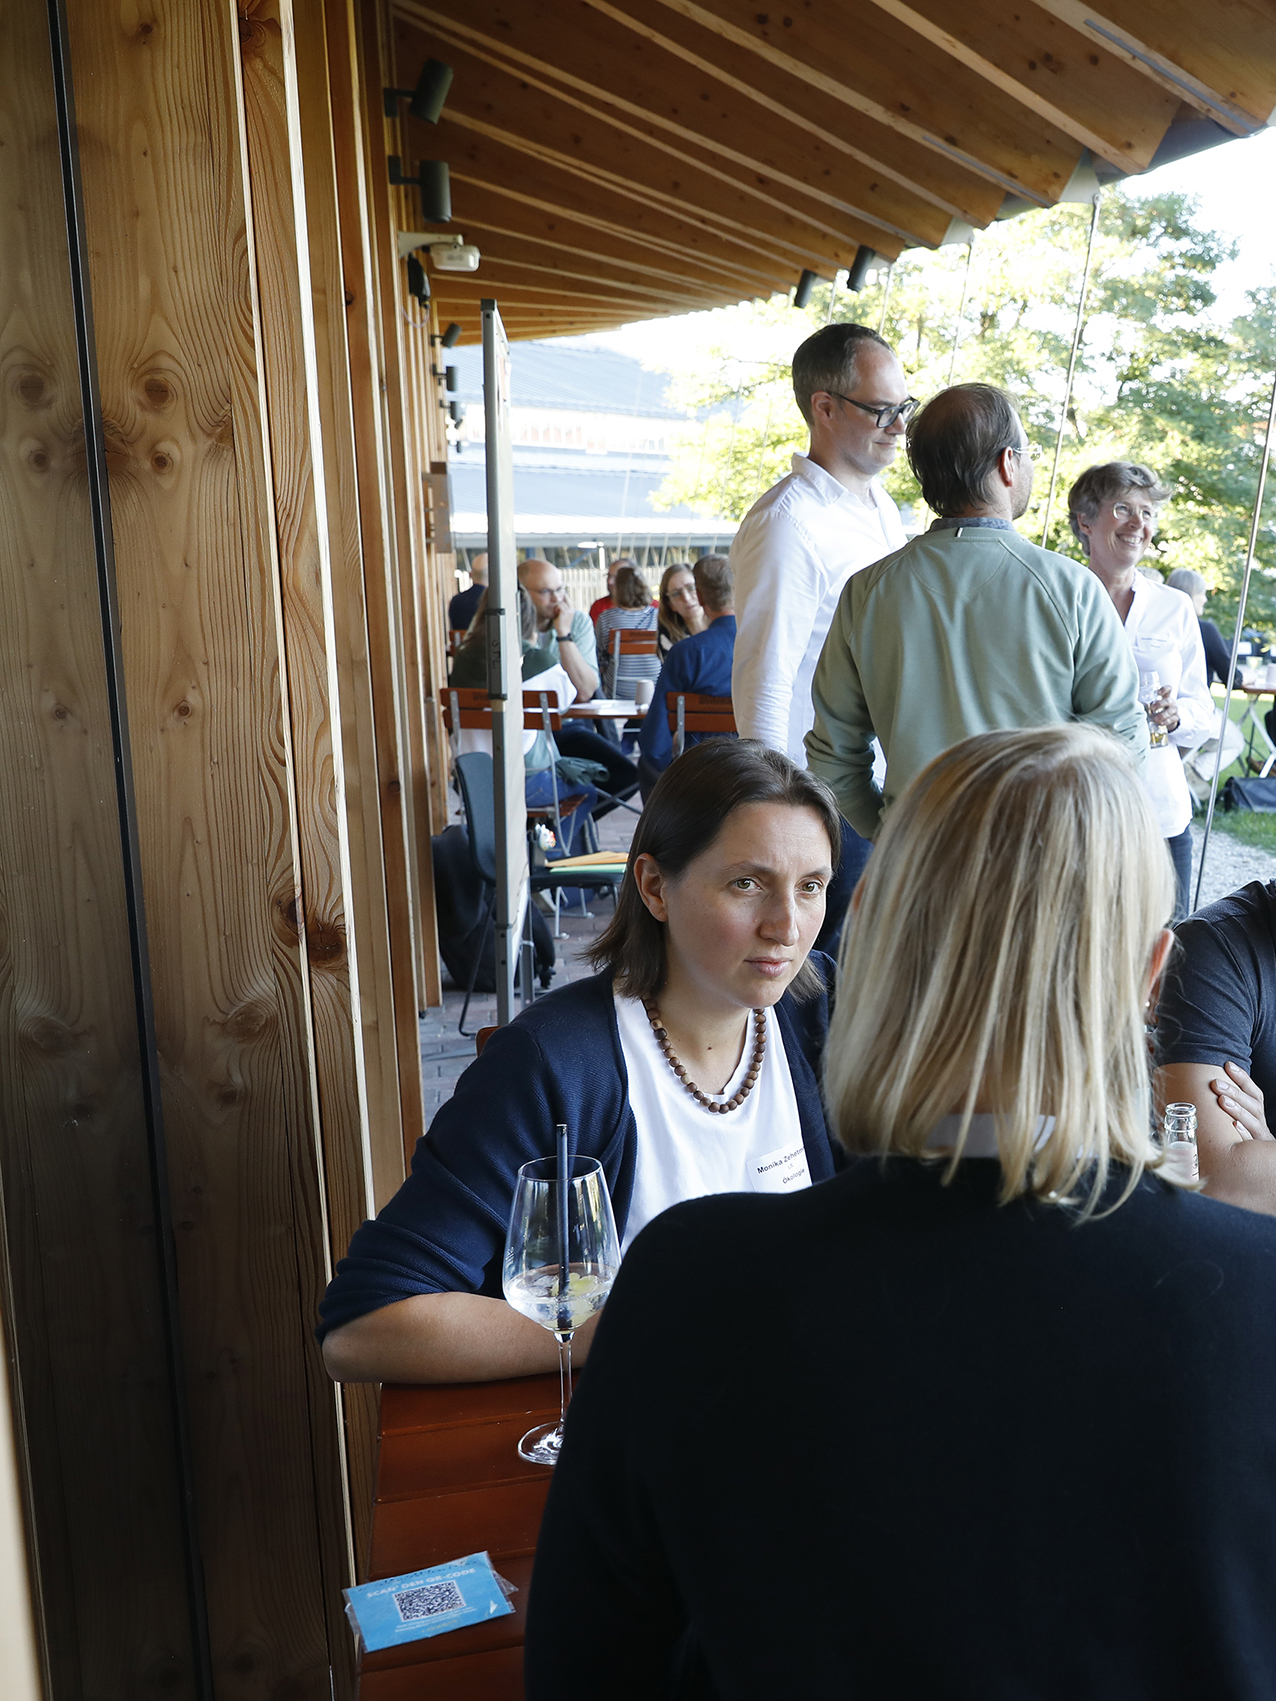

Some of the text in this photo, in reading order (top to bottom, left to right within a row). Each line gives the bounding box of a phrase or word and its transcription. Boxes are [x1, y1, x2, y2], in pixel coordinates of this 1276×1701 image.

[757, 1160, 783, 1174] Monika
[782, 1168, 805, 1184] Ökologie
[401, 1580, 424, 1589] DEN
[426, 1568, 477, 1582] QR-CODE
